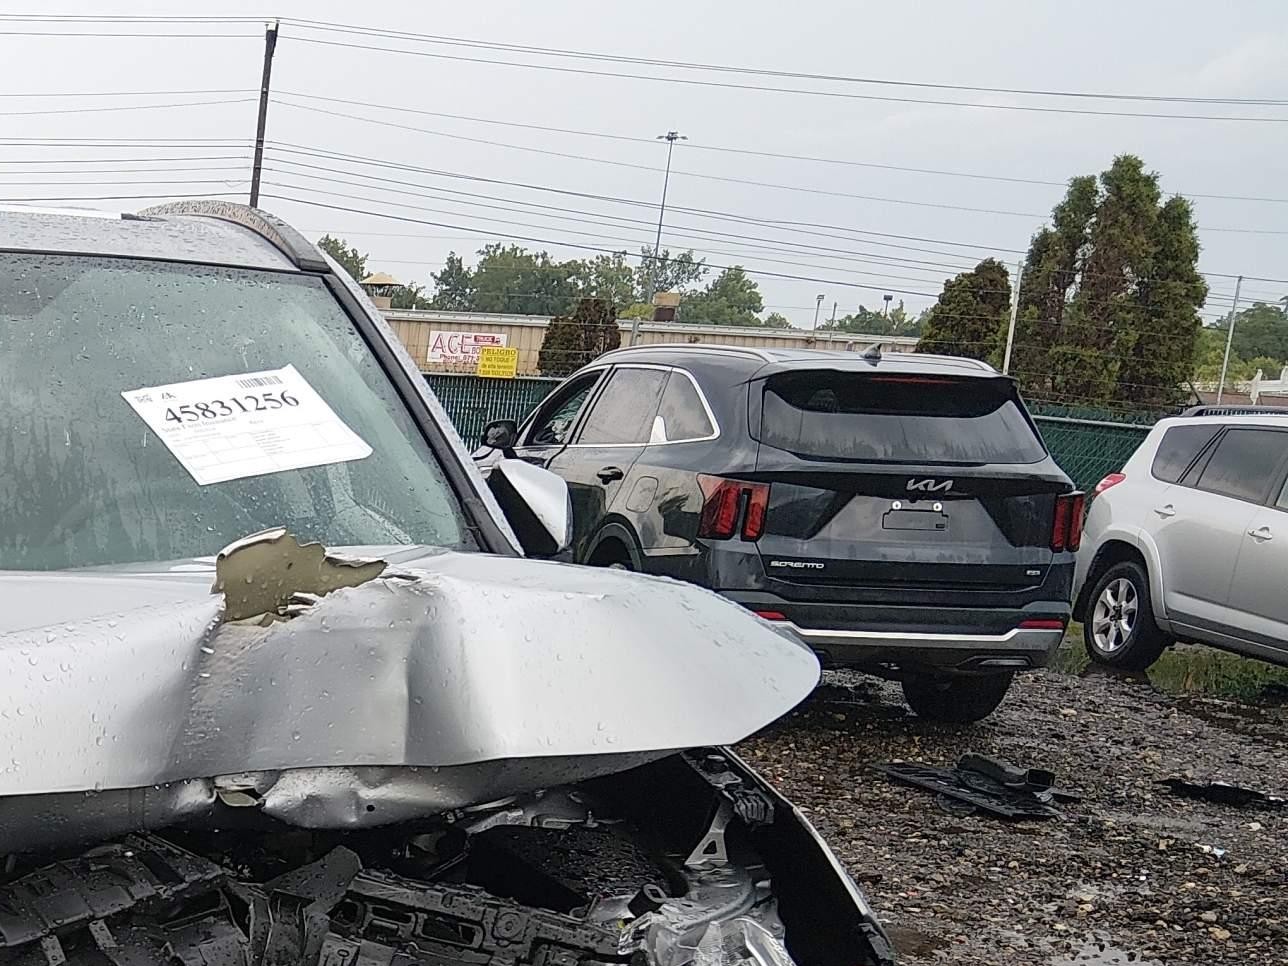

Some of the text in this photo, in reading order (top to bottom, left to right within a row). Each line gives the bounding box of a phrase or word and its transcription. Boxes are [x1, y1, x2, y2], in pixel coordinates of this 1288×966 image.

[432, 333, 471, 354] ACE
[481, 348, 517, 356] PELIGRO
[165, 389, 300, 424] 45831256
[770, 560, 825, 569] SORENTO
